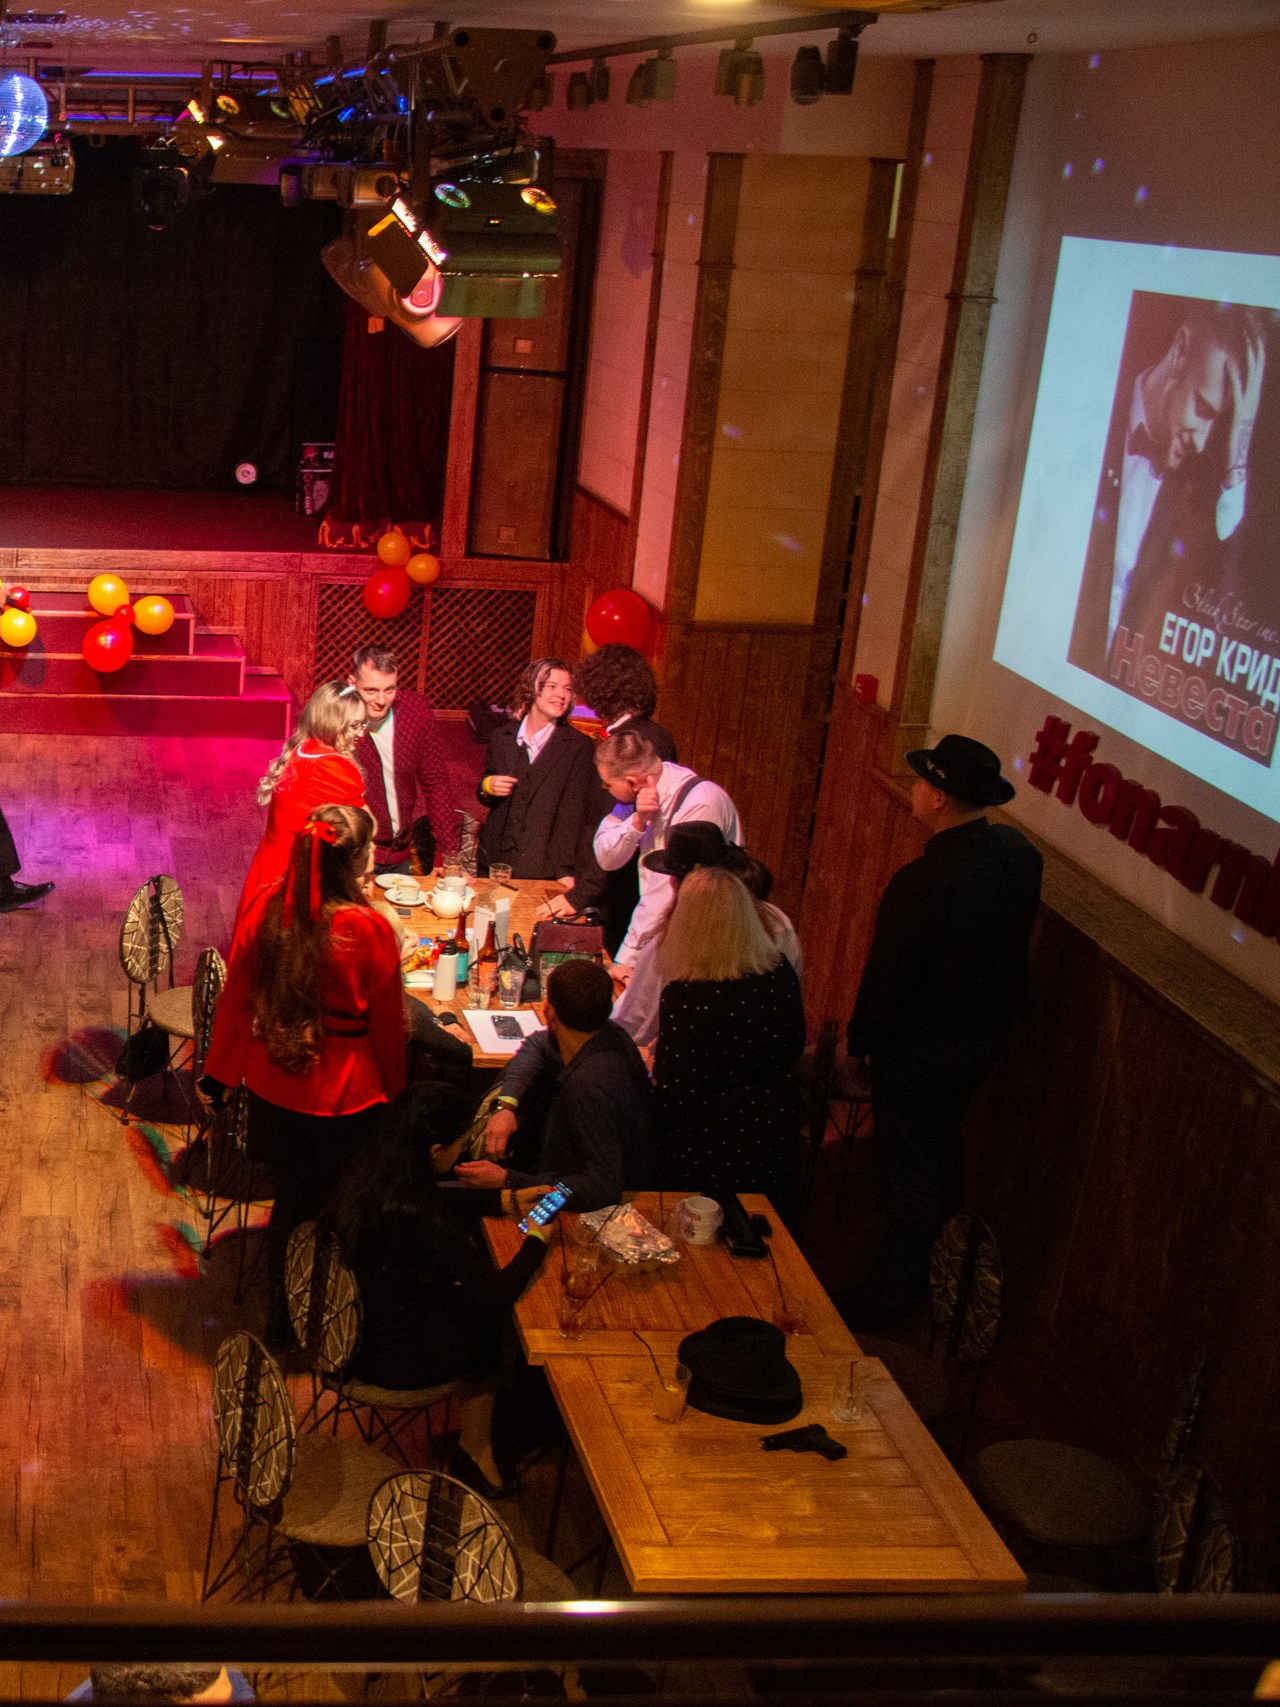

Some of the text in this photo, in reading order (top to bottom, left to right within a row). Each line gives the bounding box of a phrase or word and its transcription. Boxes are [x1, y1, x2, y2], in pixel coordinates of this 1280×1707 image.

[1109, 625, 1276, 756] Невеста
[1159, 611, 1216, 667] ЕГОР
[1028, 715, 1280, 945] #fonarn
